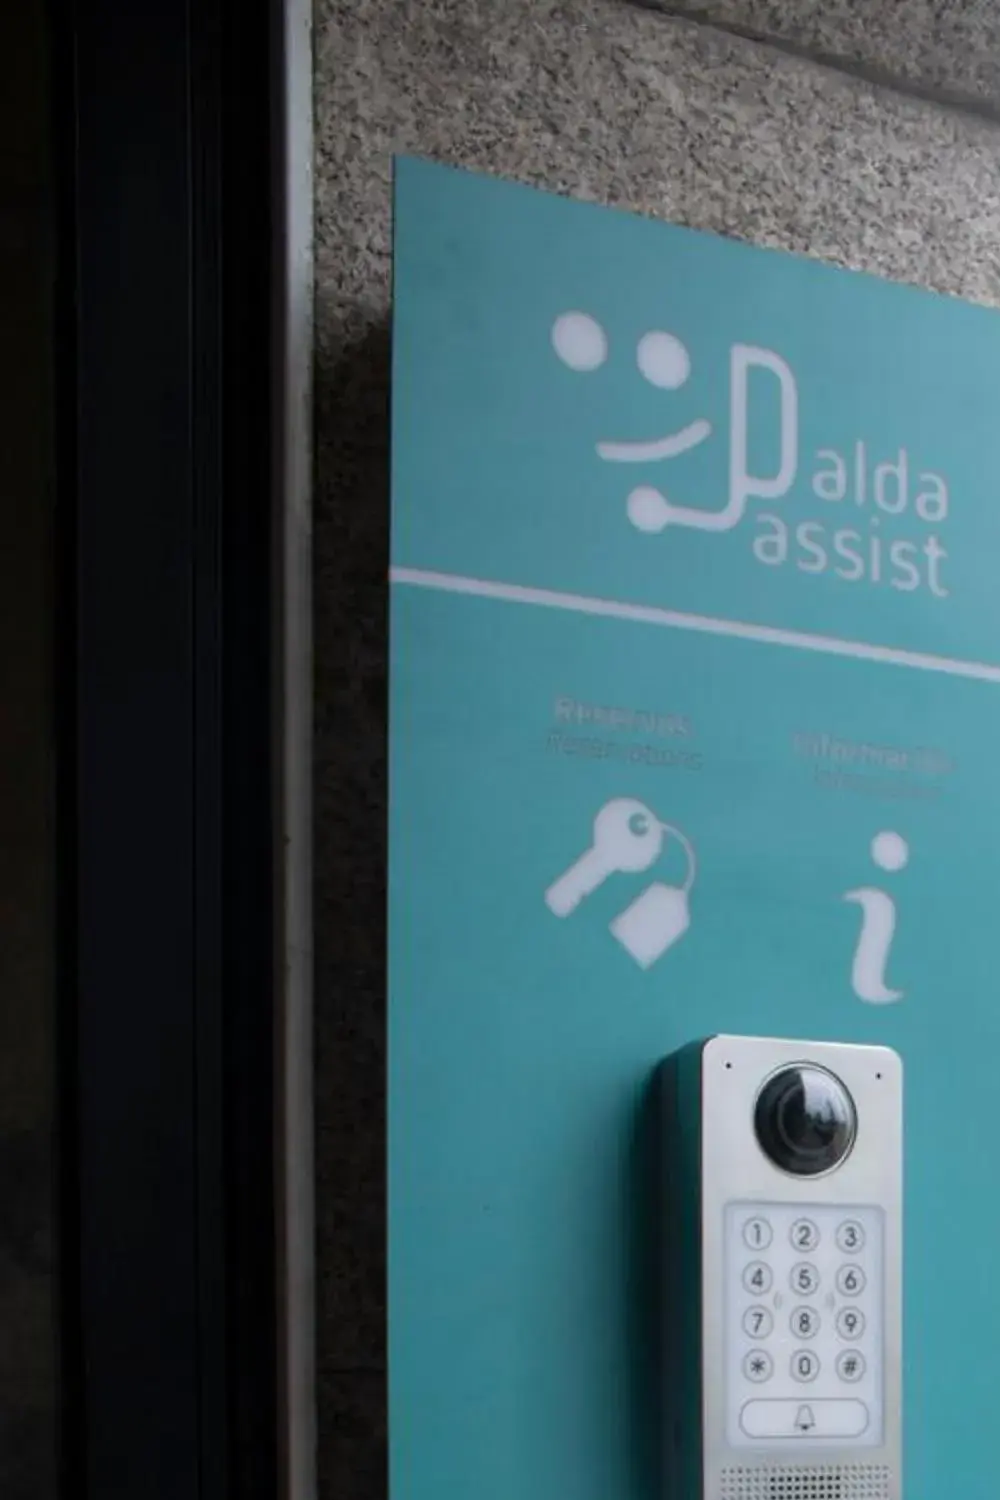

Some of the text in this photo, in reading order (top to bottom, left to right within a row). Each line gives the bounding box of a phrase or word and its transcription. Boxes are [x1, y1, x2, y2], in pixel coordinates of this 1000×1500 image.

[811, 440, 950, 524] alda
[752, 513, 951, 598] assist
[752, 1223, 858, 1248] 1 2 3
[750, 1267, 858, 1291] 4 5 6
[752, 1312, 858, 1334] 7 8 9
[798, 1355, 812, 1377] 0
